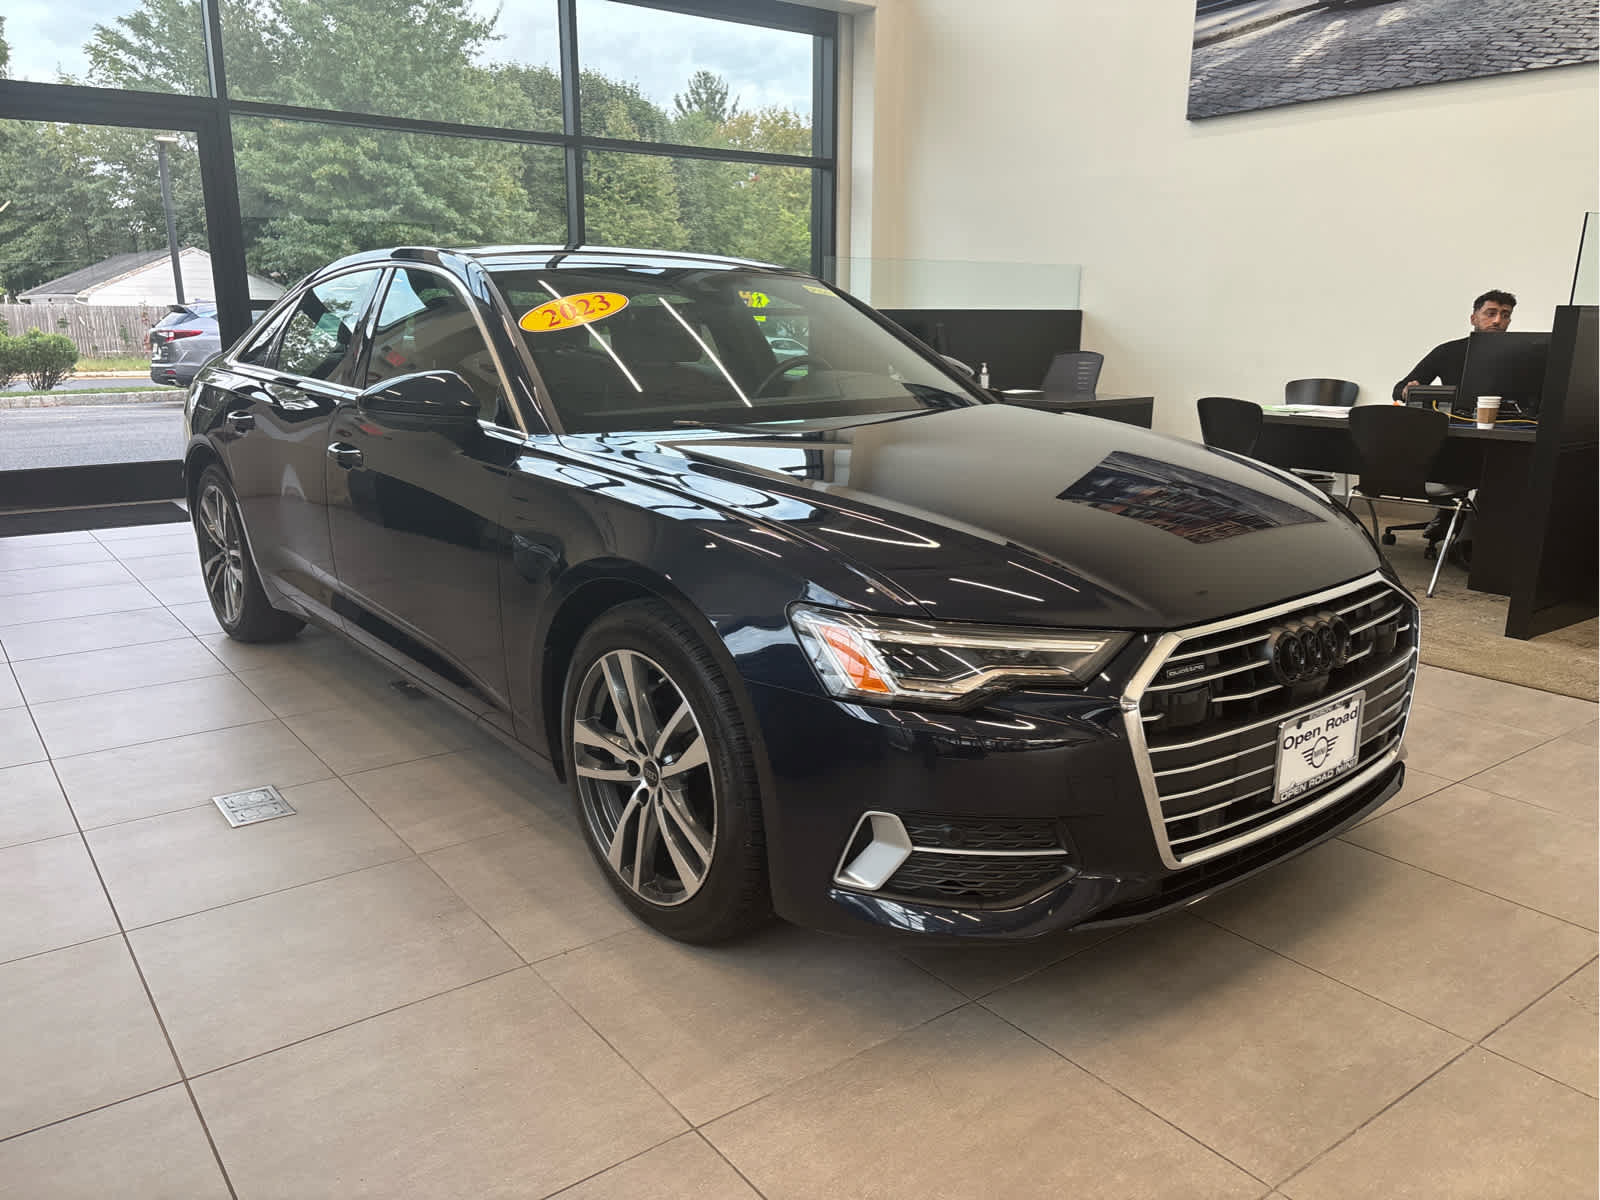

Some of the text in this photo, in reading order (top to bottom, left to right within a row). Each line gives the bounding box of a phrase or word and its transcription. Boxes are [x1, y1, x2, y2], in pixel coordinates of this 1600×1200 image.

[542, 294, 611, 327] 2023
[1283, 726, 1321, 750] Open
[1325, 706, 1358, 731] Road
[1280, 783, 1307, 801] OPEN
[1309, 769, 1335, 788] ROAD
